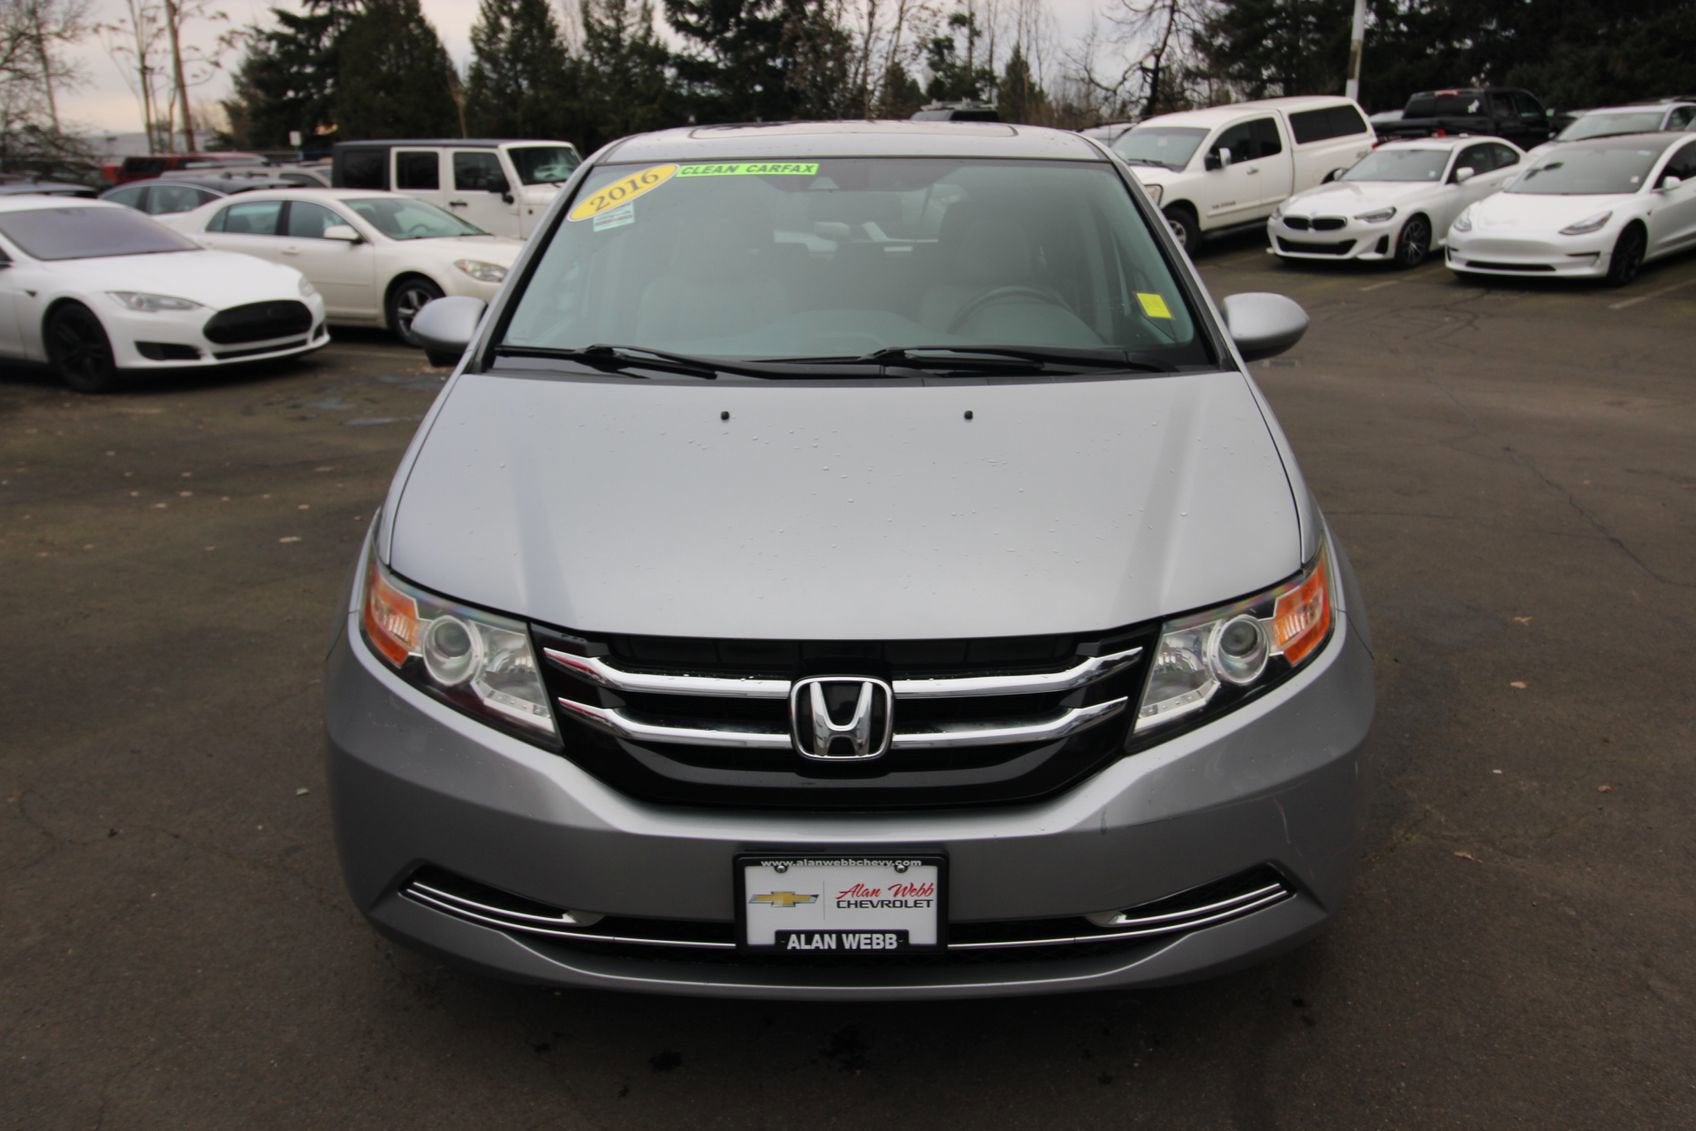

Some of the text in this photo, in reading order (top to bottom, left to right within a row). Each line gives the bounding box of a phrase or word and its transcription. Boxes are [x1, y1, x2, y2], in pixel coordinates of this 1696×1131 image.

[681, 164, 814, 175] CLEAN CARFAX
[589, 170, 660, 212] 2016
[761, 858, 922, 867] www.alanwebbchevy.com
[836, 882, 934, 900] Alan Webb
[836, 899, 934, 909] CHEVROLET
[786, 933, 899, 950] ALAN WEBB
